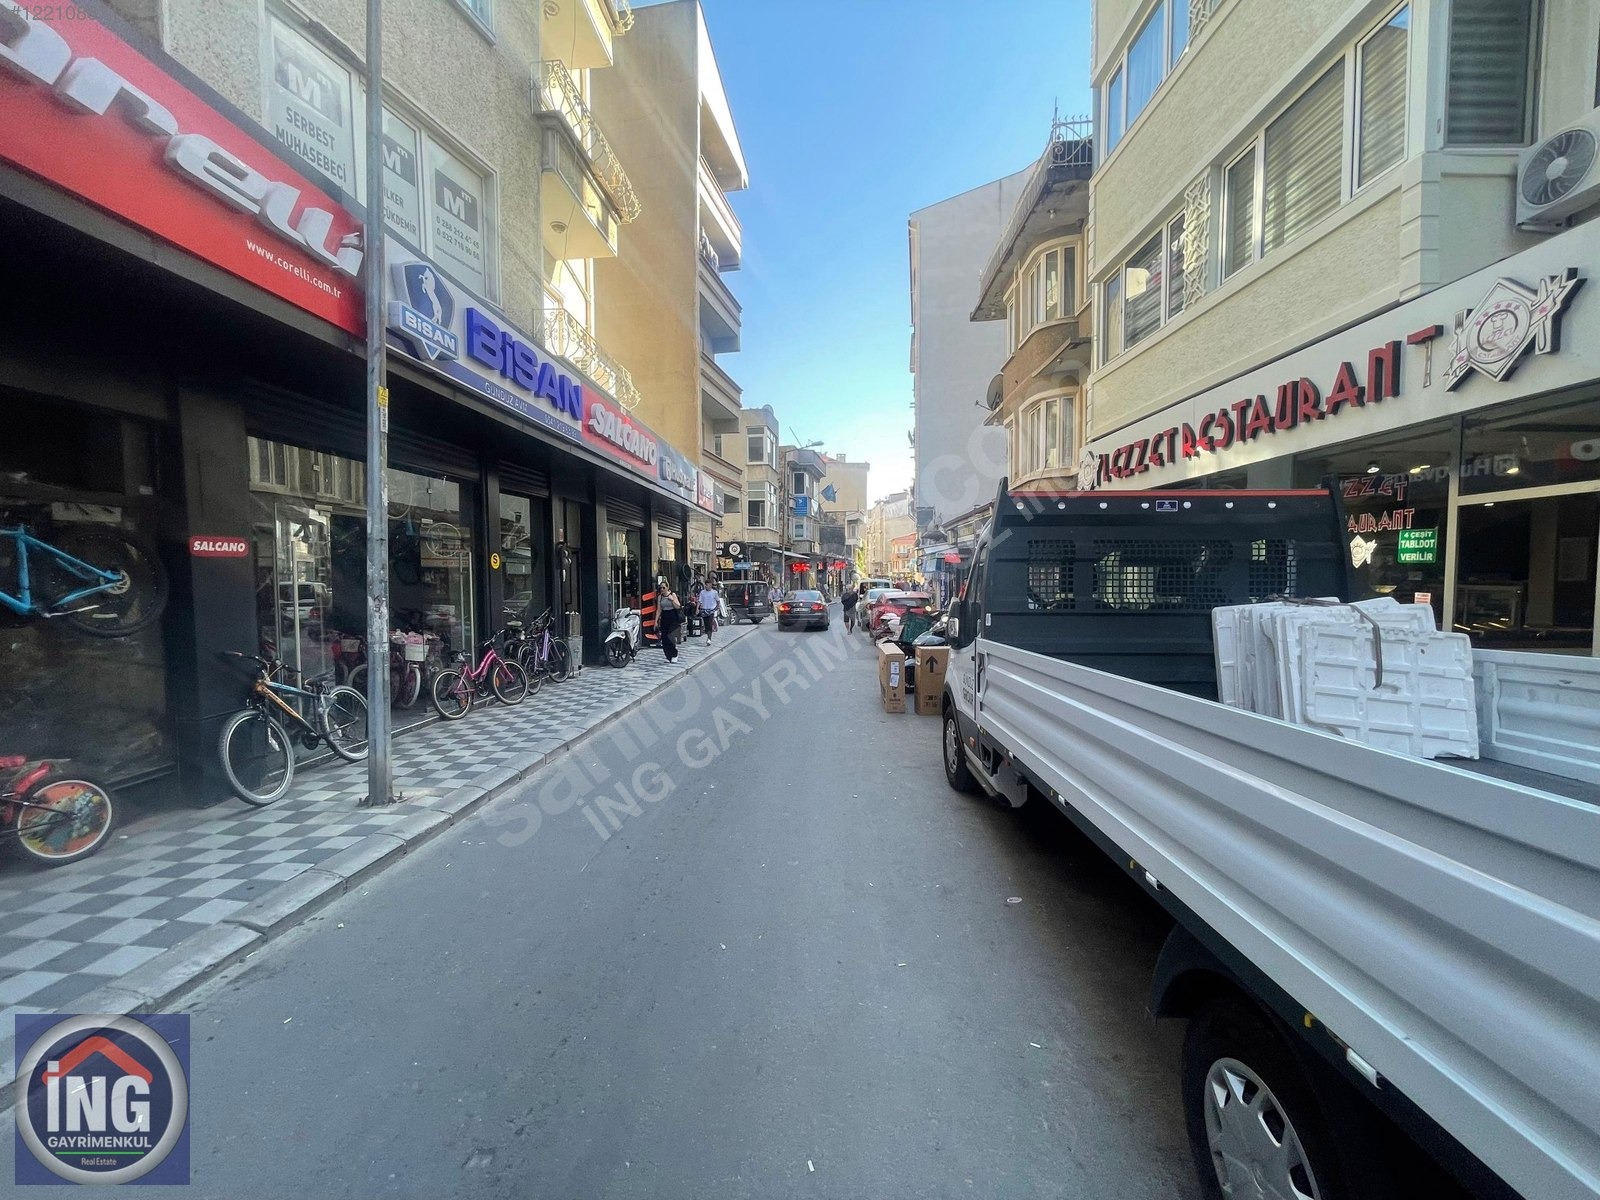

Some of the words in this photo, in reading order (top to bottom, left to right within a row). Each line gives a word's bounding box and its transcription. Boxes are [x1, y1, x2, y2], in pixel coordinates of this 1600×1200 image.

[276, 124, 347, 183] MUHASEBECİ
[286, 106, 335, 151] SERBEST
[246, 239, 342, 299] www.corelli.com.tr
[1100, 427, 1178, 483] LEZZET
[1182, 324, 1444, 460] RESTAURANT
[588, 402, 657, 466] SALCANO
[193, 540, 246, 553] SALCANO
[1400, 551, 1433, 561] VERİLİR
[1401, 540, 1435, 549] TABLDOT
